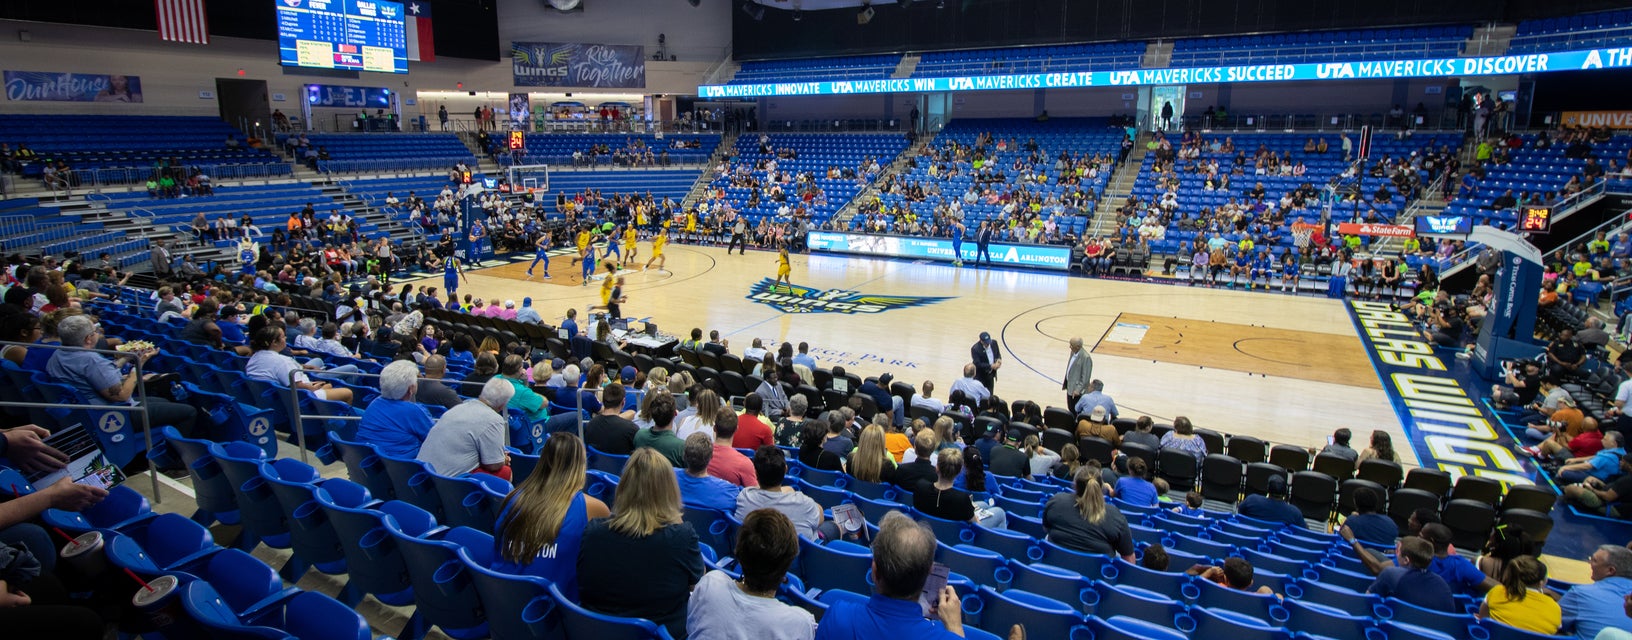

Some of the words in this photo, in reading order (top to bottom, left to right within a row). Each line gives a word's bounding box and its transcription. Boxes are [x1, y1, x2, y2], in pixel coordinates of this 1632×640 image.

[585, 45, 616, 66] Rise
[574, 59, 644, 87] Together
[1110, 71, 1141, 85] UTA
[1143, 67, 1222, 84] MAVERICKS
[1227, 64, 1295, 82] SUCCEED
[1316, 62, 1354, 78] UTA
[1358, 59, 1455, 77] MAVERICKS
[1464, 53, 1549, 75] DISCOVER
[706, 86, 725, 97] UTA
[726, 84, 772, 96] MAVERICKS
[775, 82, 820, 95] INNOVATE
[831, 81, 854, 93] UTA
[855, 79, 910, 92] MAVERICKS
[914, 78, 935, 91] WIN
[949, 77, 975, 90] UTA
[976, 75, 1041, 89] MAVERICKS
[1045, 72, 1093, 87] CREATE
[1528, 208, 1548, 218] 3:42
[1526, 217, 1543, 229] 24
[927, 246, 968, 257] UNIVERTY
[1020, 255, 1066, 264] ARLINGTON
[1350, 300, 1448, 372] DALLAS
